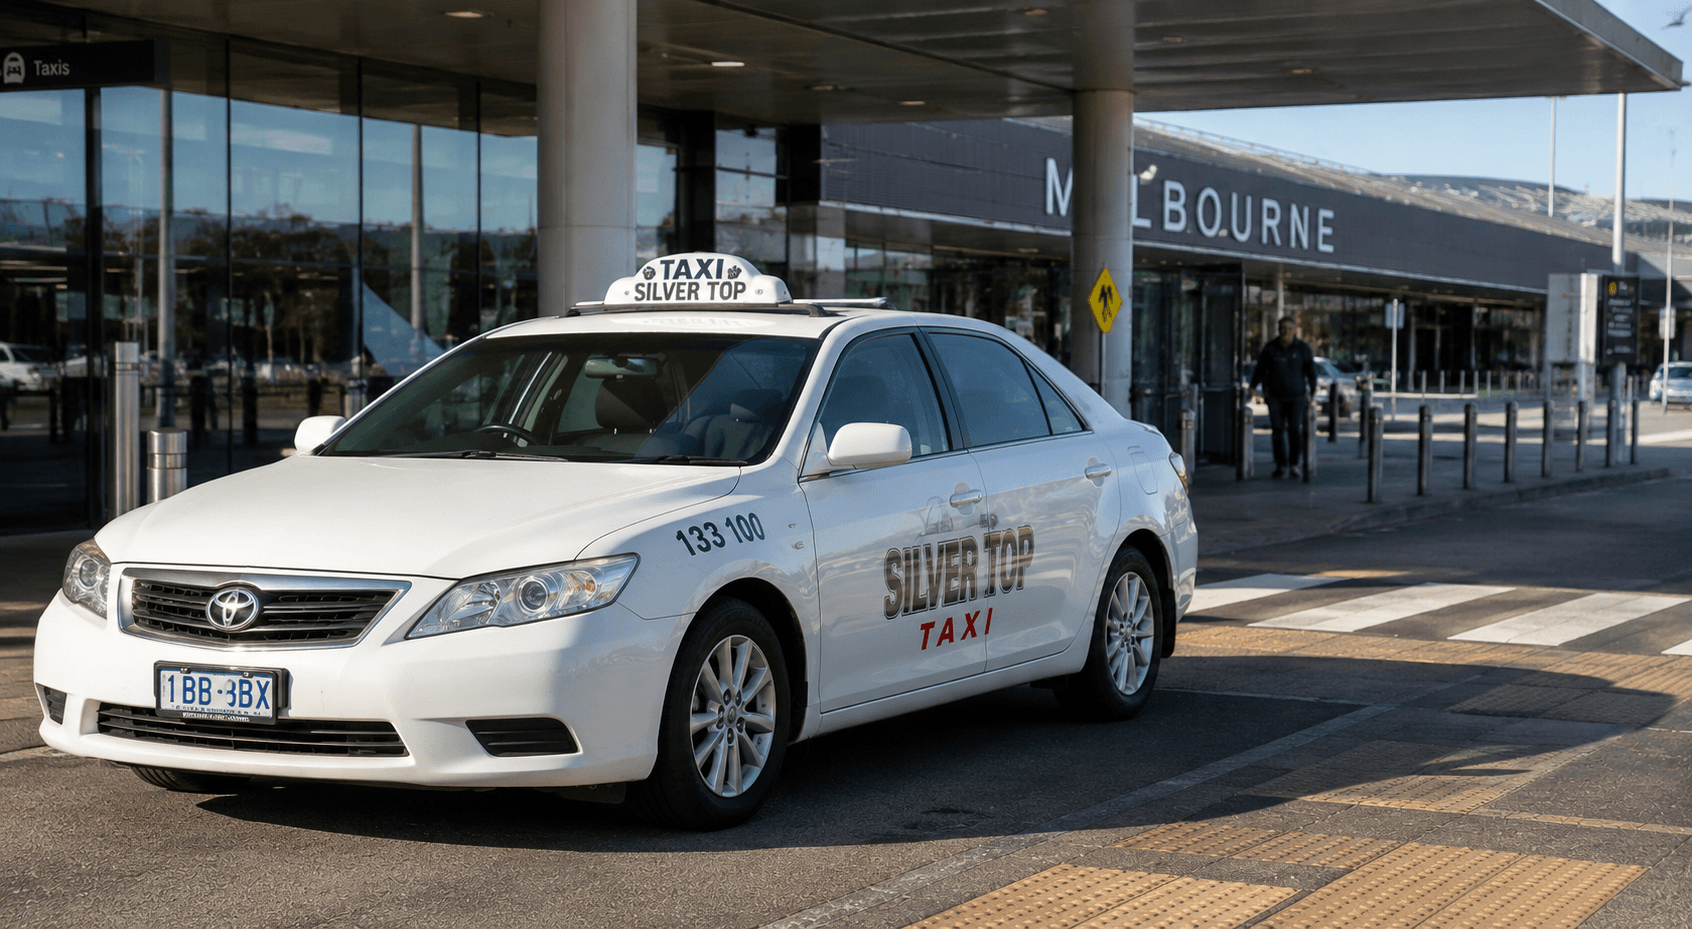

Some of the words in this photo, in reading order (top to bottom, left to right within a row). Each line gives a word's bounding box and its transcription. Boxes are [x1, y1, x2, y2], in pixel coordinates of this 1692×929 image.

[33, 59, 70, 76] Taxis
[1045, 157, 1335, 253] MLBOURNE
[660, 258, 724, 280] TAXI
[634, 281, 700, 301] SILVER
[707, 281, 747, 301] TOP
[676, 521, 726, 556] 133
[725, 512, 765, 543] 100
[883, 535, 979, 620] SILVER
[983, 524, 1034, 598] TOP
[920, 607, 993, 650] TAXI
